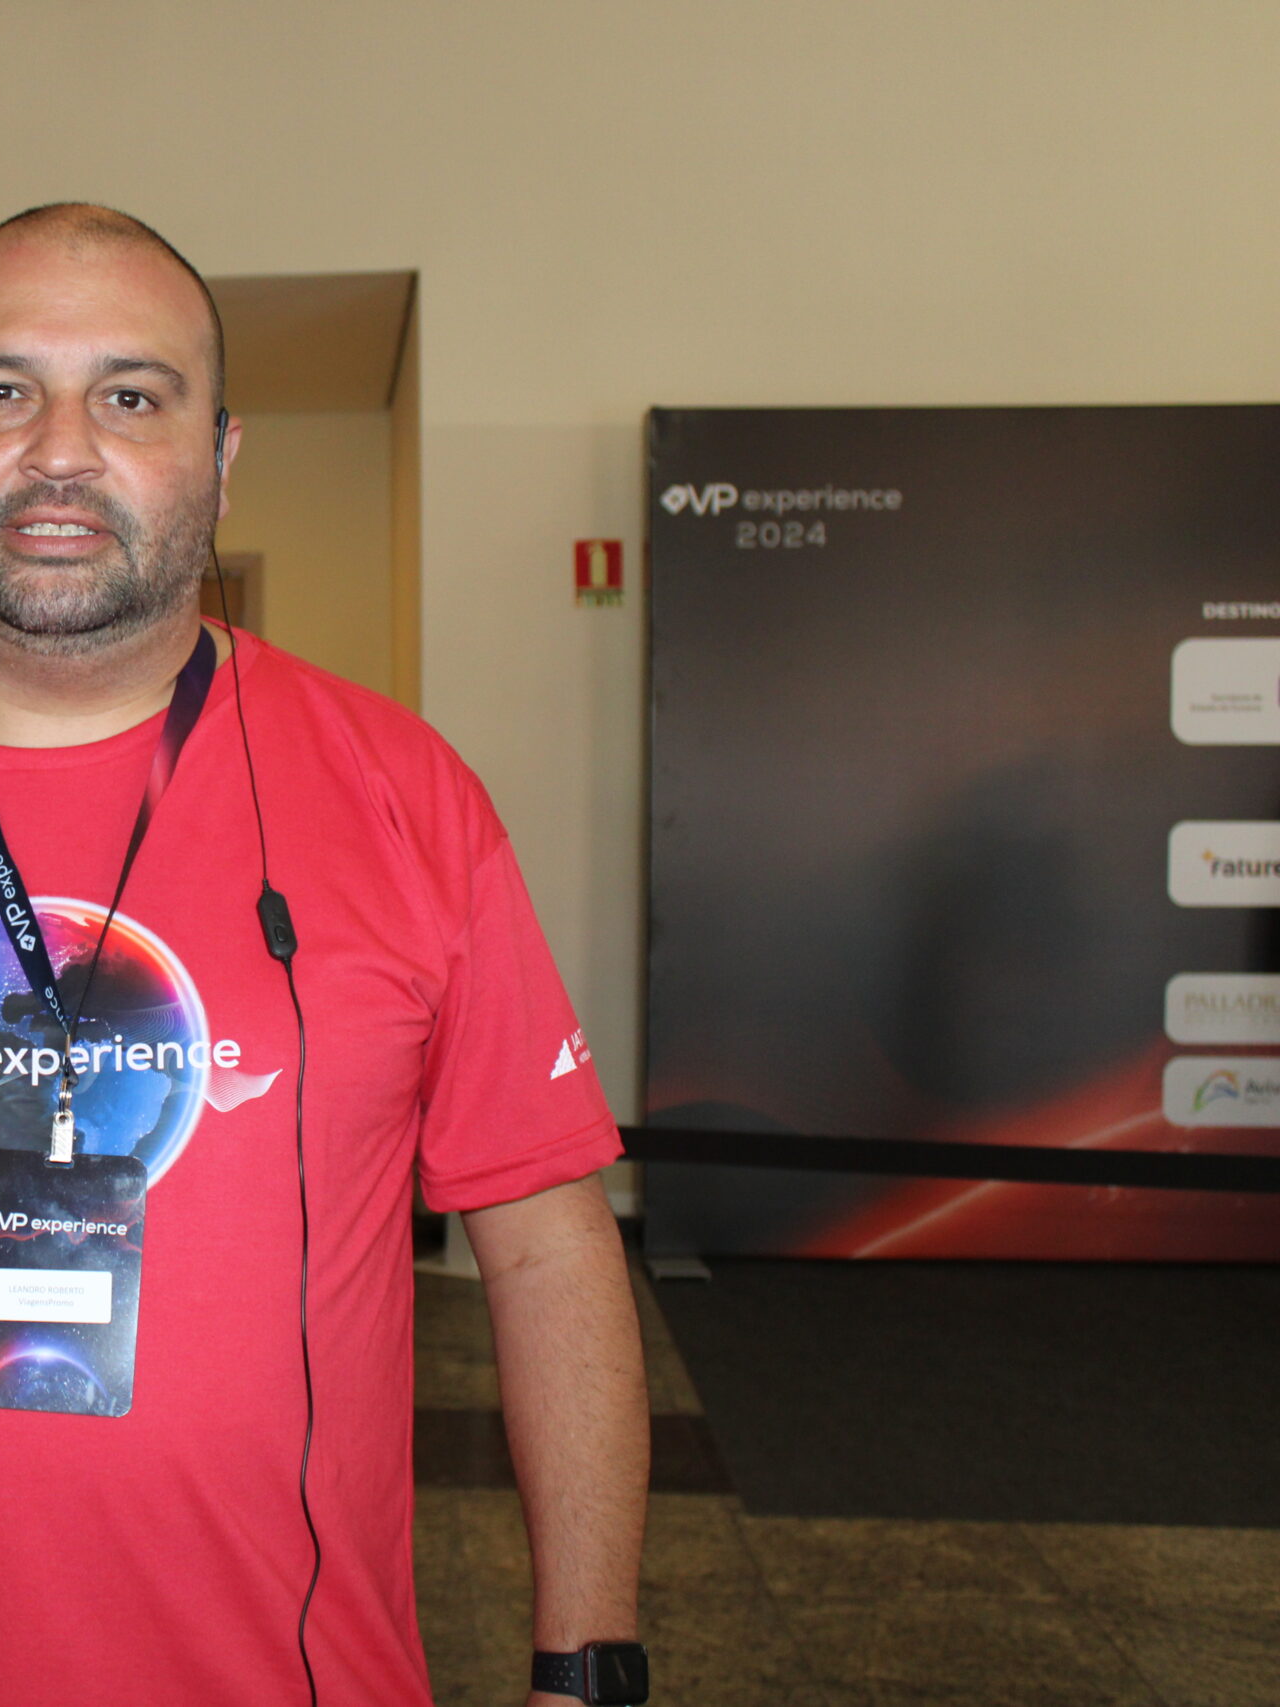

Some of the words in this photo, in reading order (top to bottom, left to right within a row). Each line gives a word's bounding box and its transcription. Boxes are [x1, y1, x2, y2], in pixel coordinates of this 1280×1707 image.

[742, 484, 903, 516] experience
[735, 521, 827, 549] 2024
[31, 1218, 128, 1236] experience
